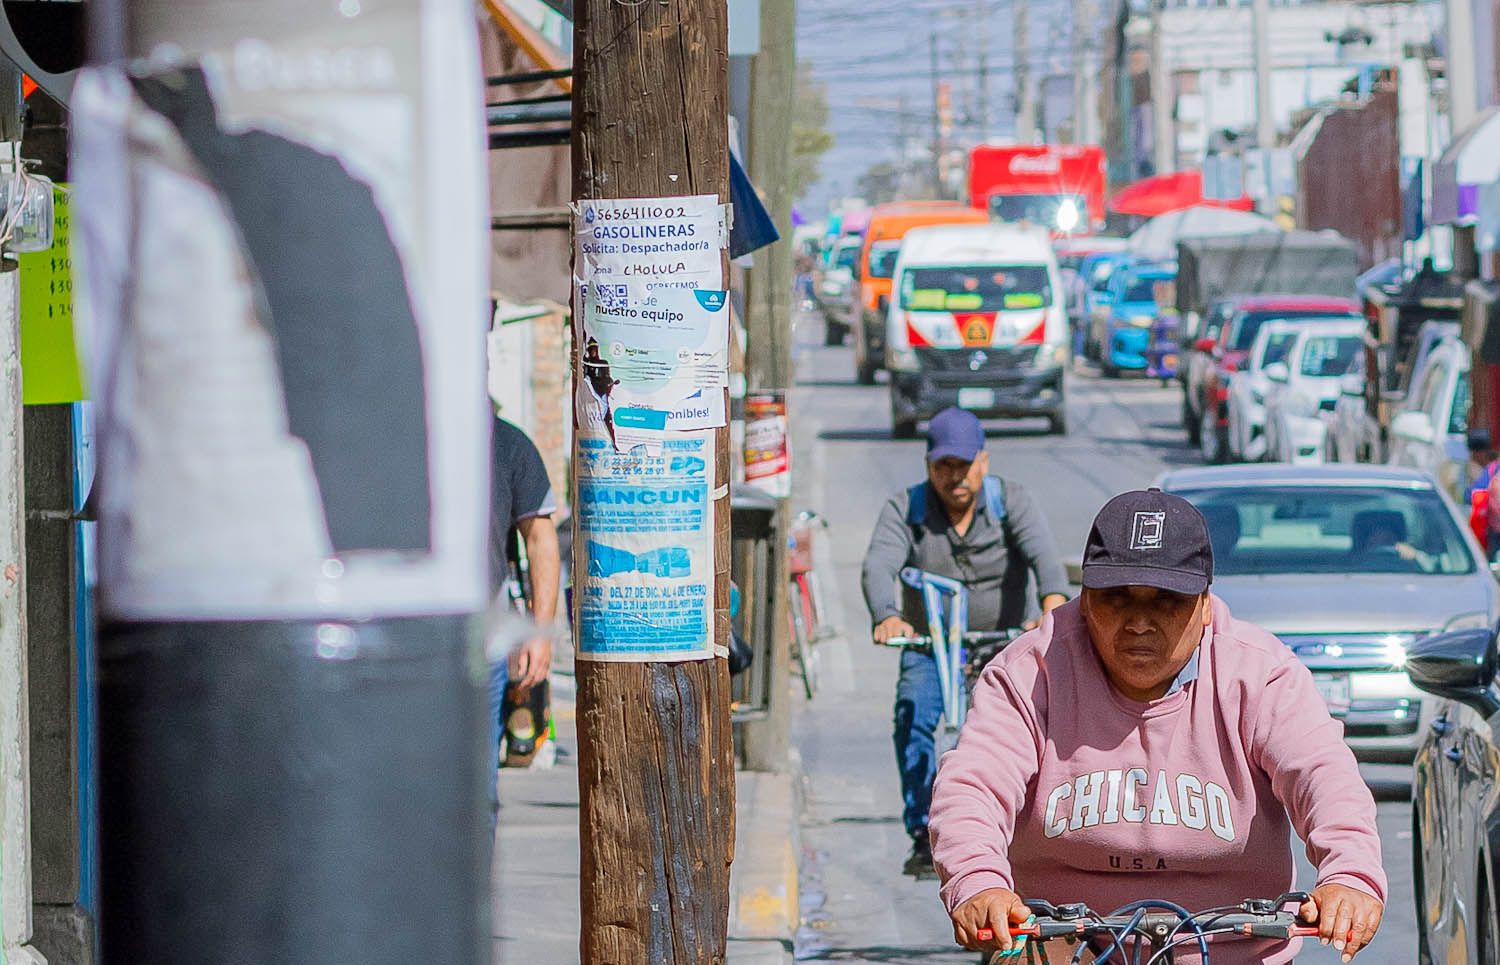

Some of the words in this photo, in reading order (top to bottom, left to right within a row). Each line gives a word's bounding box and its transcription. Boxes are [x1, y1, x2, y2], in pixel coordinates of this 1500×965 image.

[597, 207, 687, 220] 5656411002
[593, 224, 695, 239] GASOLINERAS
[583, 243, 619, 254] Solicita:
[622, 240, 709, 255] Despachador/a
[624, 262, 686, 276] CHOLULA
[595, 304, 638, 318] nuestro
[641, 309, 684, 323] equipo
[668, 408, 710, 419] onibles!
[1044, 768, 1235, 842] CHICAGO
